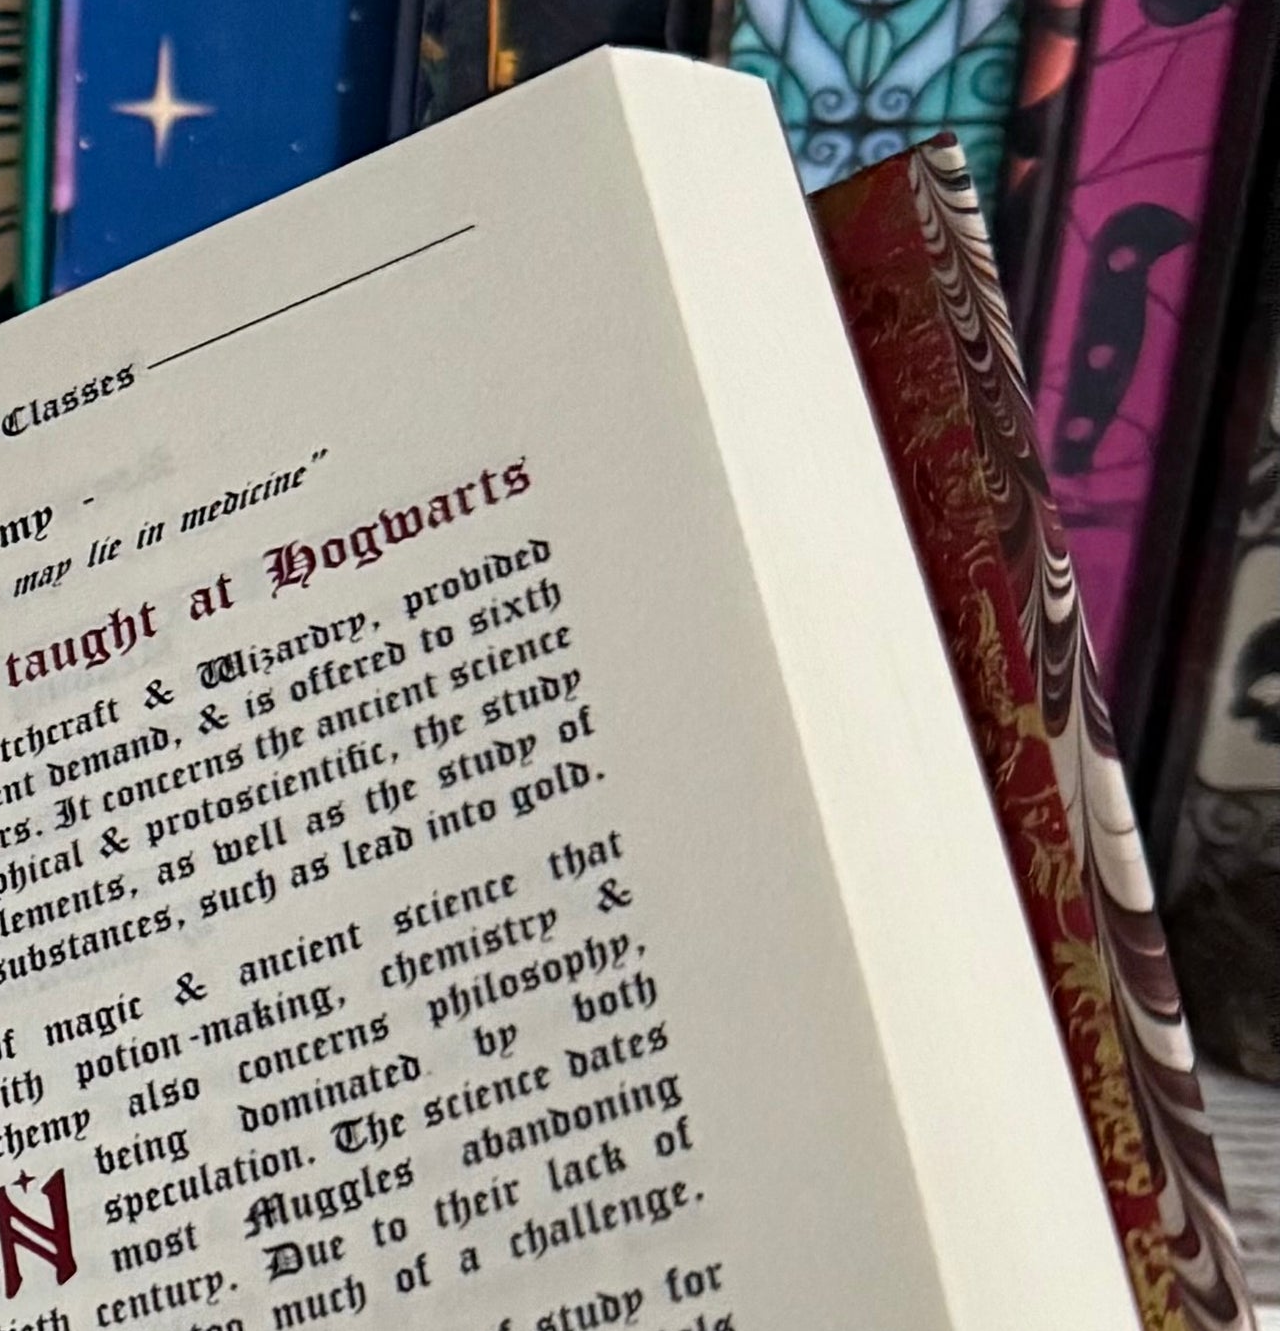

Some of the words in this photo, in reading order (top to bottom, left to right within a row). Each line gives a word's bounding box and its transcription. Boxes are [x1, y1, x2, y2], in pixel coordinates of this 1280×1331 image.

[1, 362, 135, 437] Classes
[5, 601, 158, 688] taught
[189, 572, 235, 621] at
[262, 455, 531, 600] Hogwarts
[13, 557, 73, 598] may
[86, 538, 123, 569] lie
[136, 521, 166, 550] in
[143, 678, 175, 711] &
[196, 611, 381, 690] Wizardry,
[402, 538, 552, 621] provided
[53, 794, 92, 831] It
[102, 742, 245, 813] concerns
[254, 725, 305, 761] the
[317, 672, 439, 740] ancient
[449, 625, 572, 691] science
[157, 850, 196, 886] as
[212, 816, 288, 866] well
[305, 799, 346, 837] as
[364, 778, 418, 815] the
[437, 733, 537, 790] study
[558, 704, 596, 744] of
[43, 996, 144, 1047] magic
[174, 971, 209, 1007] &
[239, 922, 363, 987] ancient
[393, 873, 518, 936] science
[547, 829, 623, 881] that
[380, 907, 558, 989] chemistry
[596, 877, 633, 915] &
[104, 1145, 316, 1225] speculation.
[329, 1111, 407, 1155] The
[423, 1065, 551, 1129] science
[564, 1020, 669, 1079] dates
[96, 1270, 238, 1328] century.
[261, 1235, 346, 1283] Due
[371, 1217, 408, 1249] to
[434, 1179, 520, 1230] their
[547, 1140, 628, 1193] lack
[654, 1114, 694, 1158] of
[664, 1262, 723, 1304] for
